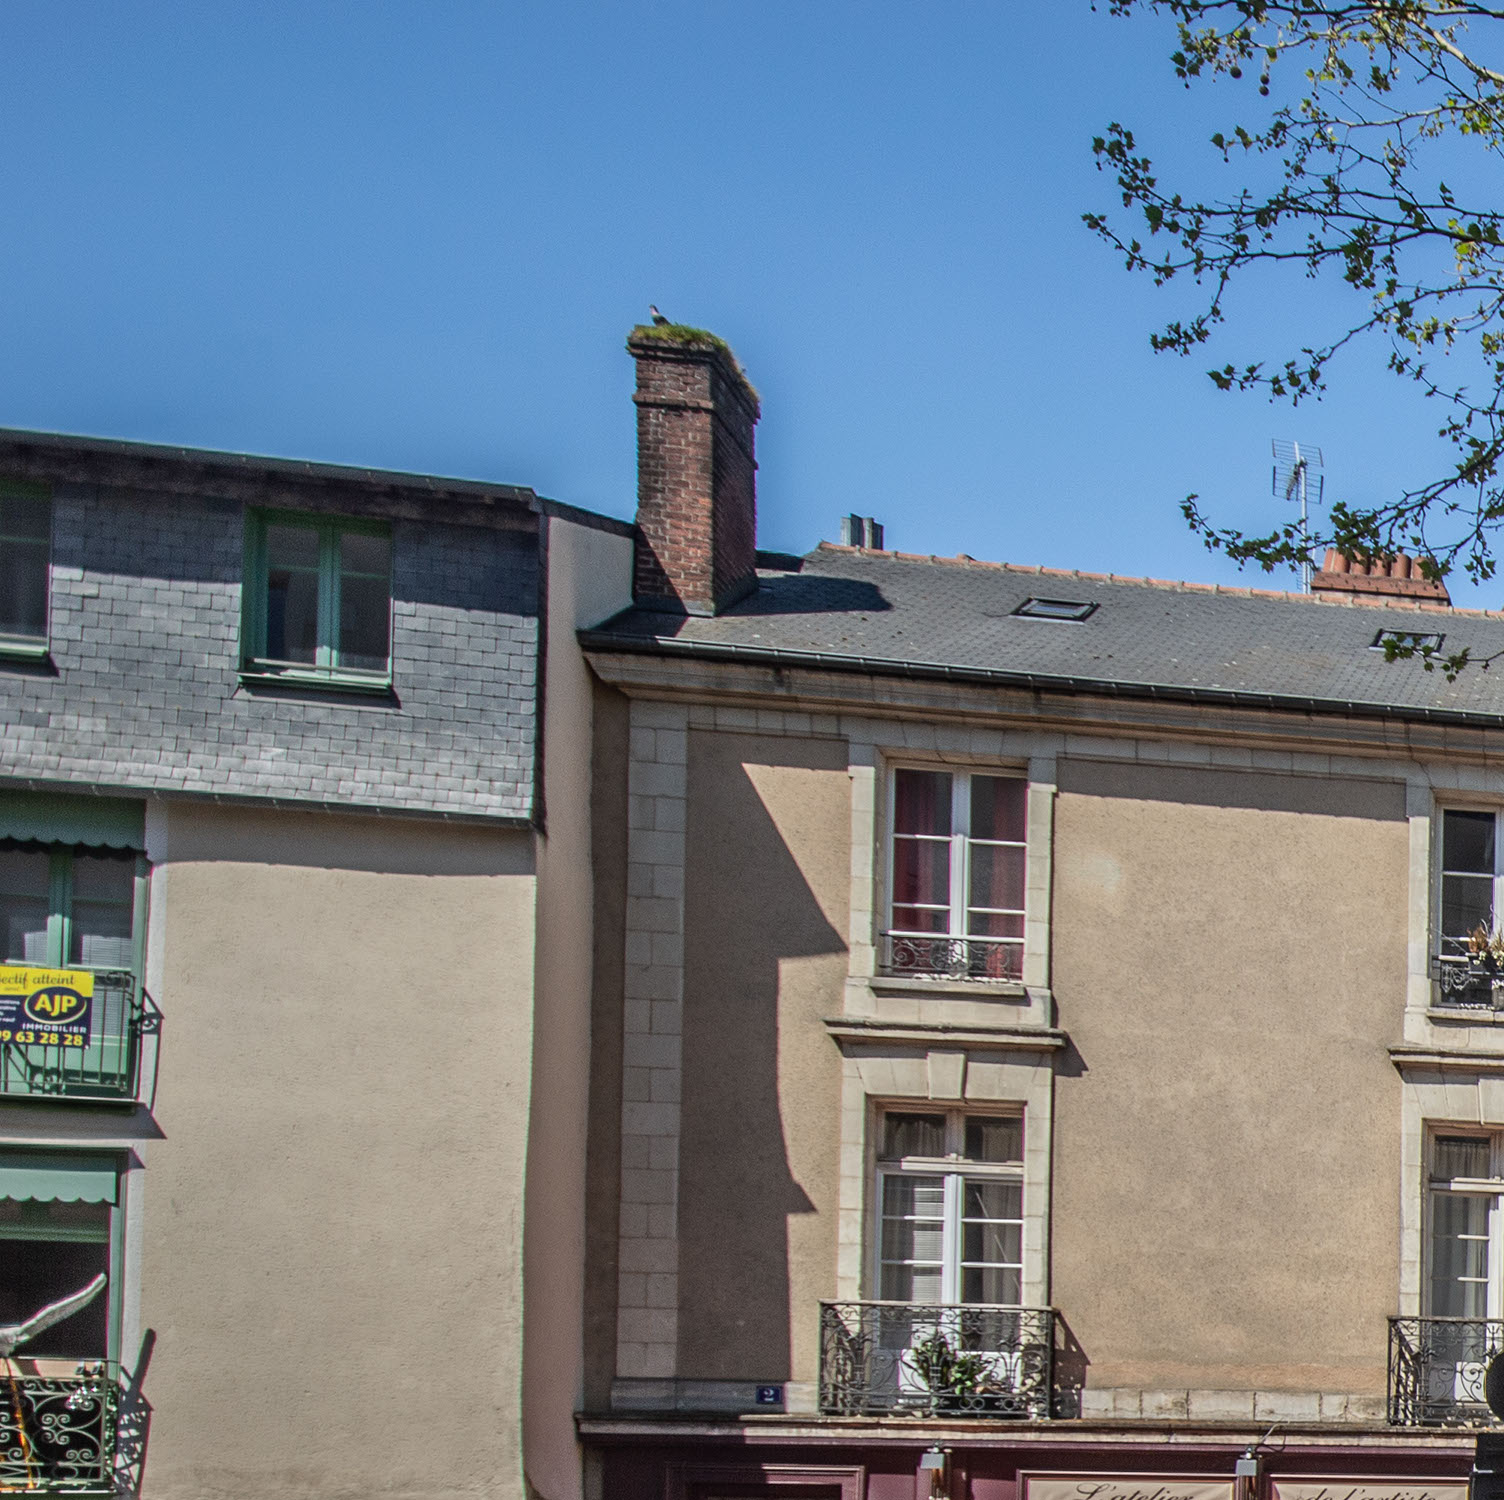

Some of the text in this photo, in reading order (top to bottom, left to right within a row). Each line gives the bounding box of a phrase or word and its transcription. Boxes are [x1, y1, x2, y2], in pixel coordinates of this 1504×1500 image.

[33, 975, 74, 985] atteint
[34, 994, 77, 1016] AJP
[23, 1023, 87, 1032] IMMOBILIER
[16, 1031, 35, 1043] 63
[38, 1032, 58, 1044] 28
[63, 1034, 83, 1046] 28
[763, 1388, 775, 1402] 2
